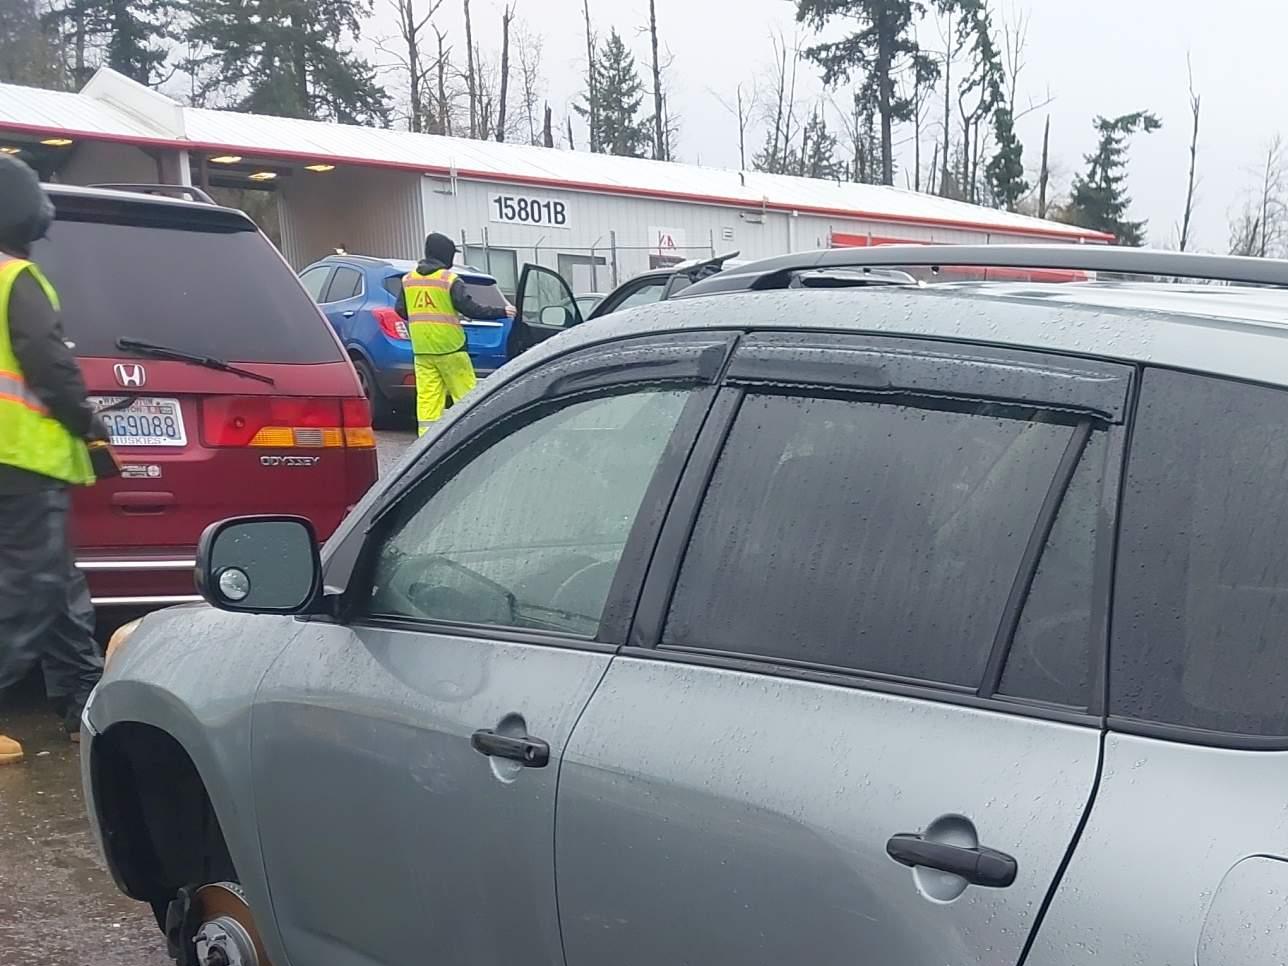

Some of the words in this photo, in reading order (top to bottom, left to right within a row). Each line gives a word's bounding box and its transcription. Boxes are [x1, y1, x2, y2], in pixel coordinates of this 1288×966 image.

[493, 195, 566, 225] 15801B
[111, 436, 161, 444] HUSKIES
[260, 455, 320, 466] ODYSSEY
